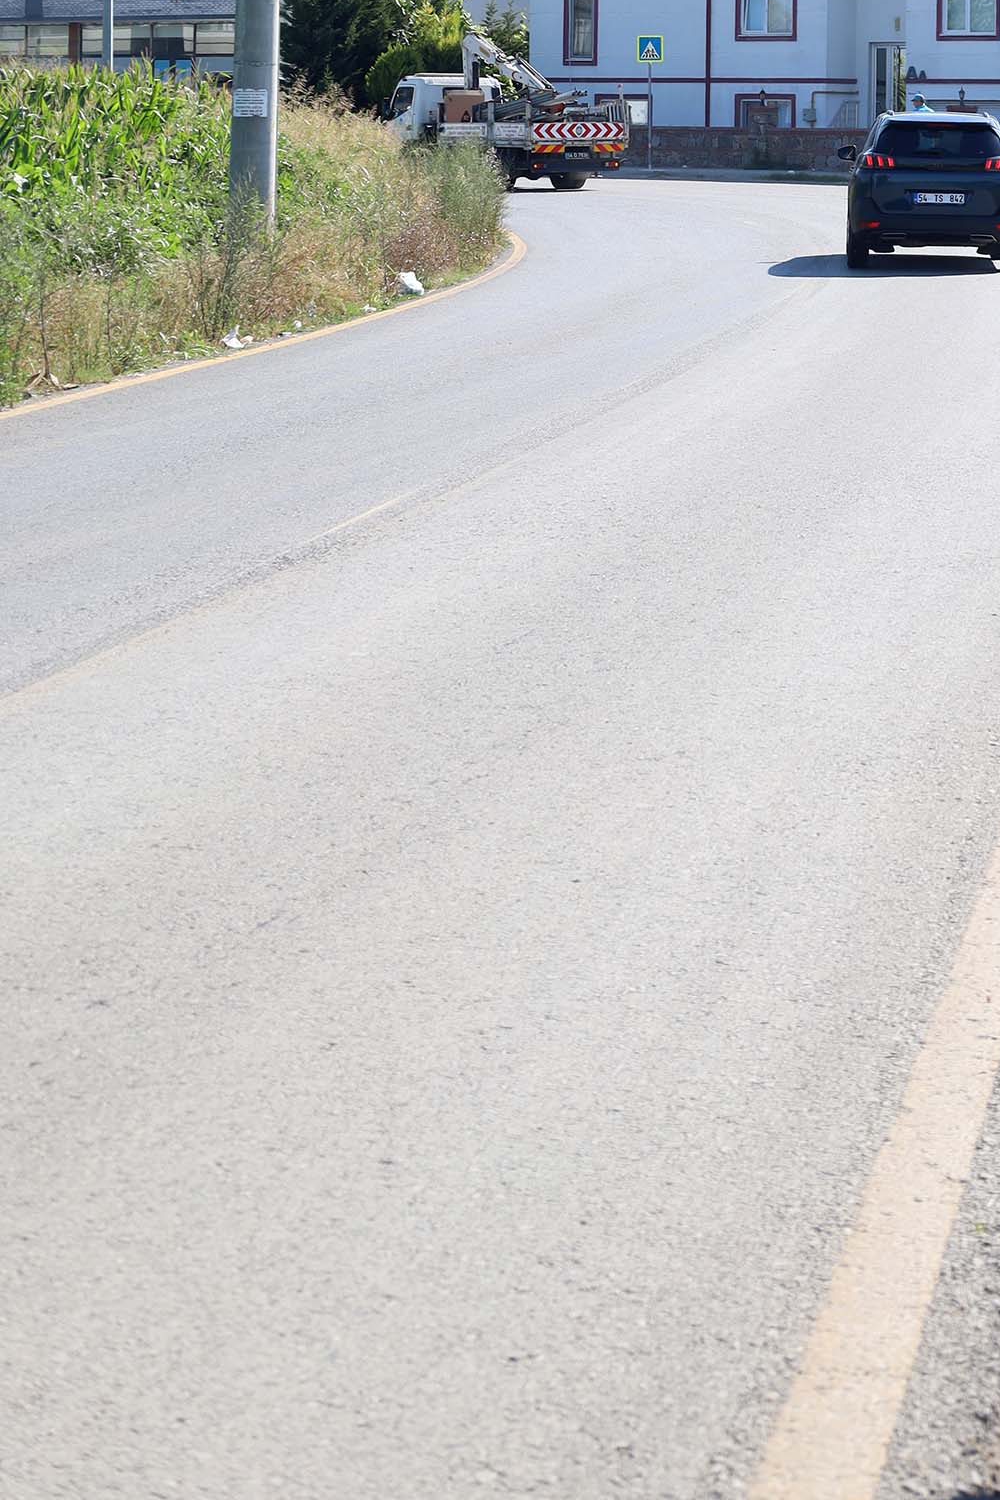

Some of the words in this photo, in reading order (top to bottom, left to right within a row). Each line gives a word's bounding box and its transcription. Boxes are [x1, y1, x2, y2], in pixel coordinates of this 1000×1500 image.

[919, 194, 928, 202] 54
[935, 194, 944, 202] TS
[950, 194, 964, 202] 842
